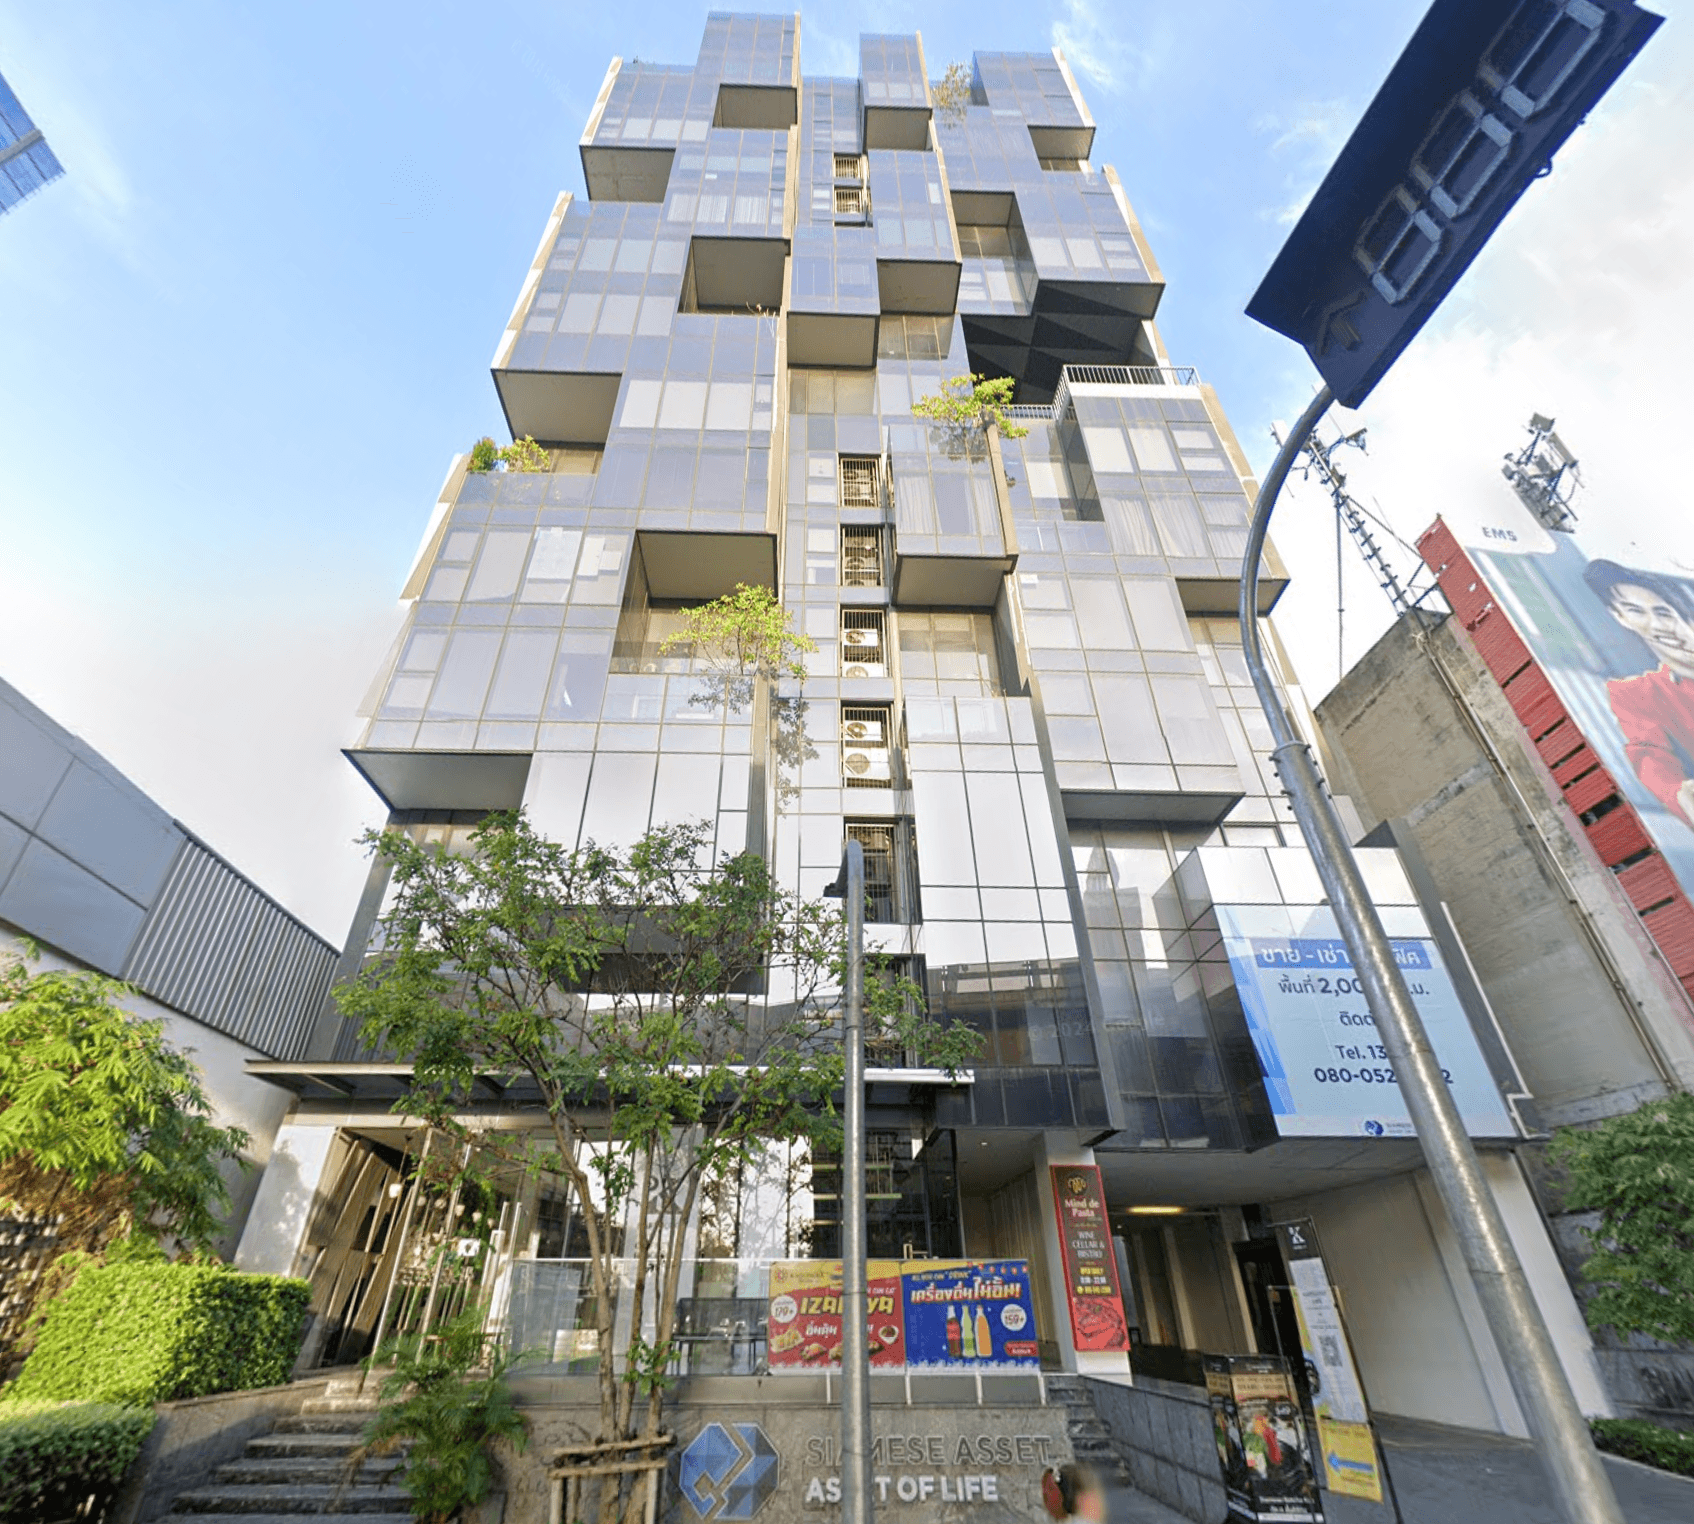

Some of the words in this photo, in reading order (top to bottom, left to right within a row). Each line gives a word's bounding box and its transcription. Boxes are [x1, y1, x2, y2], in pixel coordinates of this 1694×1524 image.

[1482, 526, 1518, 542] EMS
[1261, 948, 1302, 963] ขาย
[1278, 973, 1315, 994] พื้นที่
[1317, 977, 1364, 997] 2,00
[1335, 1044, 1366, 1060] Tel.
[1367, 1044, 1388, 1060] 13
[1088, 1198, 1100, 1208] de
[800, 1295, 895, 1316] IZAYA
[805, 1434, 944, 1467] SIMESE
[953, 1434, 1052, 1466] ASSET
[805, 1475, 891, 1504] AST
[897, 1475, 934, 1503] OF
[942, 1475, 999, 1503] LIFE
